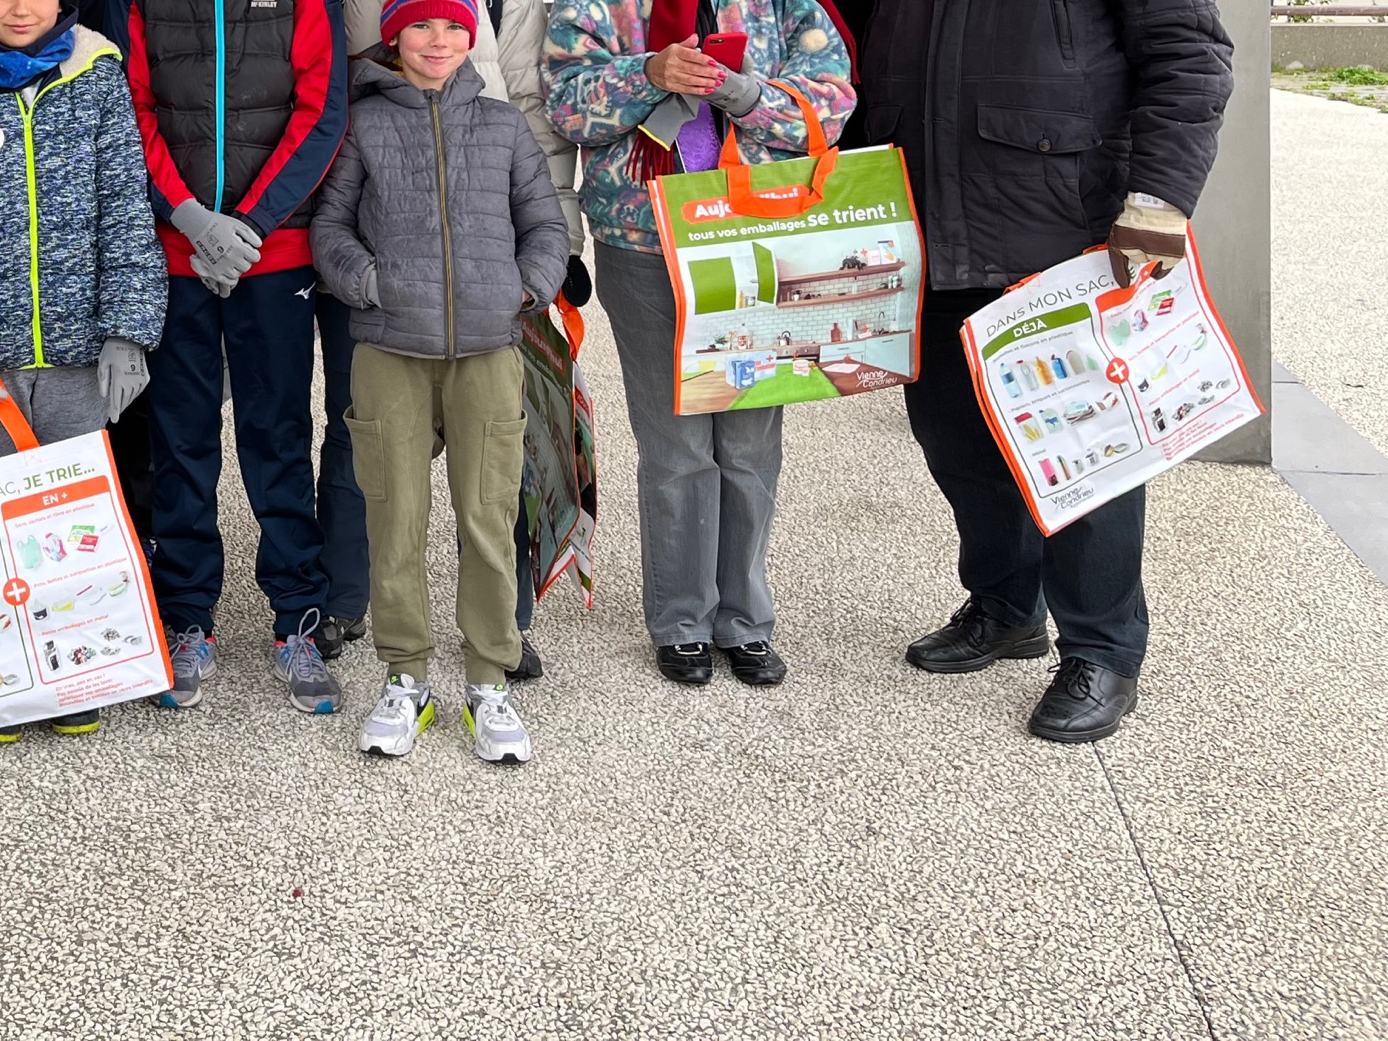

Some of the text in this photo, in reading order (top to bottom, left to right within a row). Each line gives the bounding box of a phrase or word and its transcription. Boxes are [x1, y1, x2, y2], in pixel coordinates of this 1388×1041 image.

[688, 231, 715, 241] tous
[717, 229, 738, 237] vos
[740, 220, 806, 235] emballages
[807, 211, 829, 227] se
[832, 203, 887, 224] trient
[986, 307, 1026, 337] DANS
[1028, 288, 1073, 312] MON
[1013, 319, 1048, 338] DÉJÀ
[23, 474, 43, 490] JE
[42, 493, 59, 506] EN
